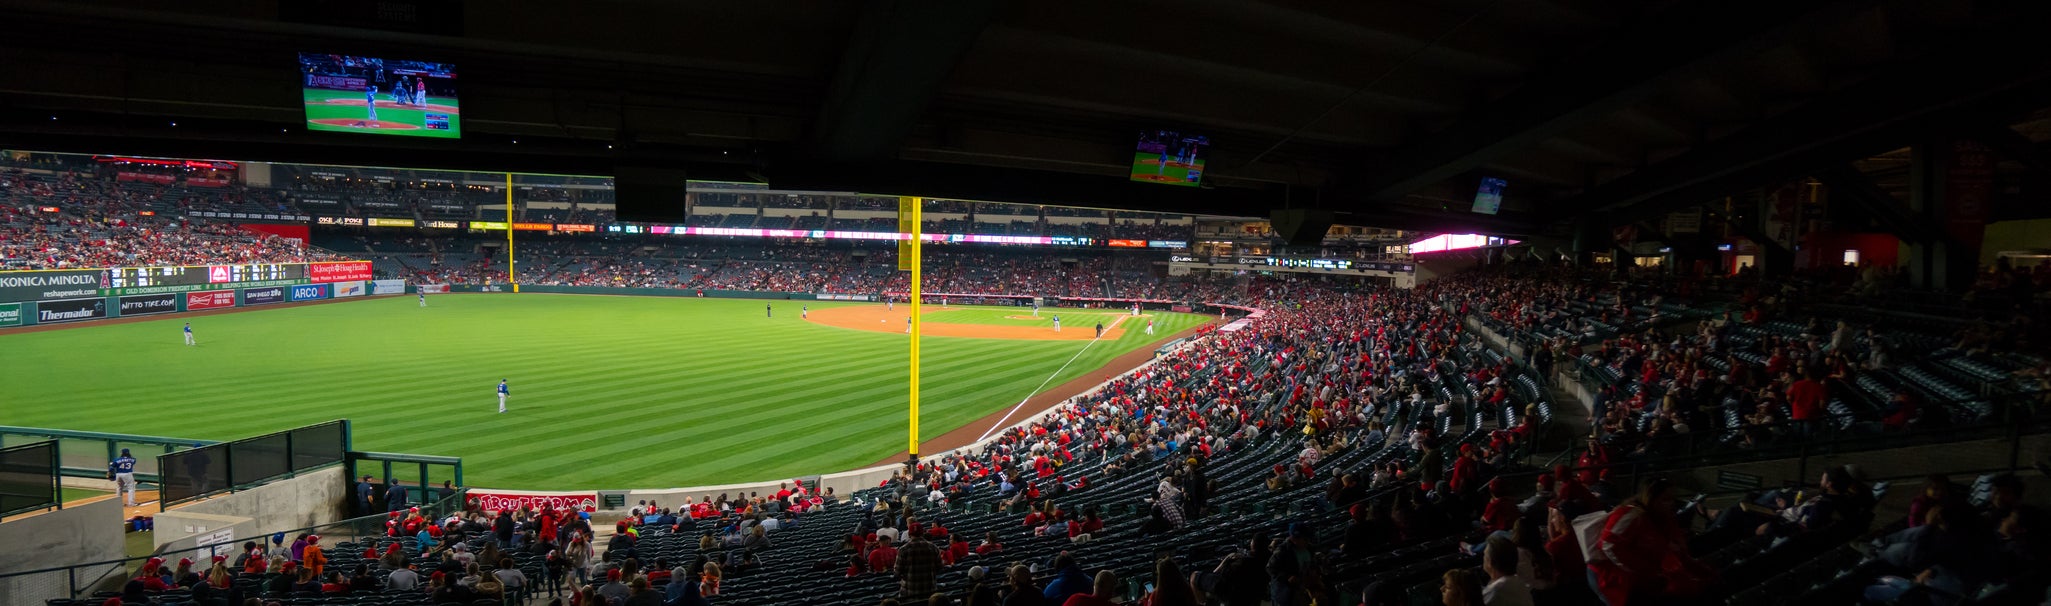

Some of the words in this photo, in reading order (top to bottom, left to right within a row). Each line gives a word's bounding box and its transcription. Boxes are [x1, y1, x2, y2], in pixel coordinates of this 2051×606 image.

[423, 220, 437, 228] Yard
[438, 220, 458, 229] House
[0, 276, 47, 288] KONICA
[48, 274, 97, 286] MINOLTA
[43, 288, 97, 298] reshapework.com
[294, 287, 318, 299] ARCO
[121, 301, 143, 310] NITTO
[41, 307, 95, 321] Thermador
[119, 462, 132, 470] 43
[481, 494, 529, 511] TROUT
